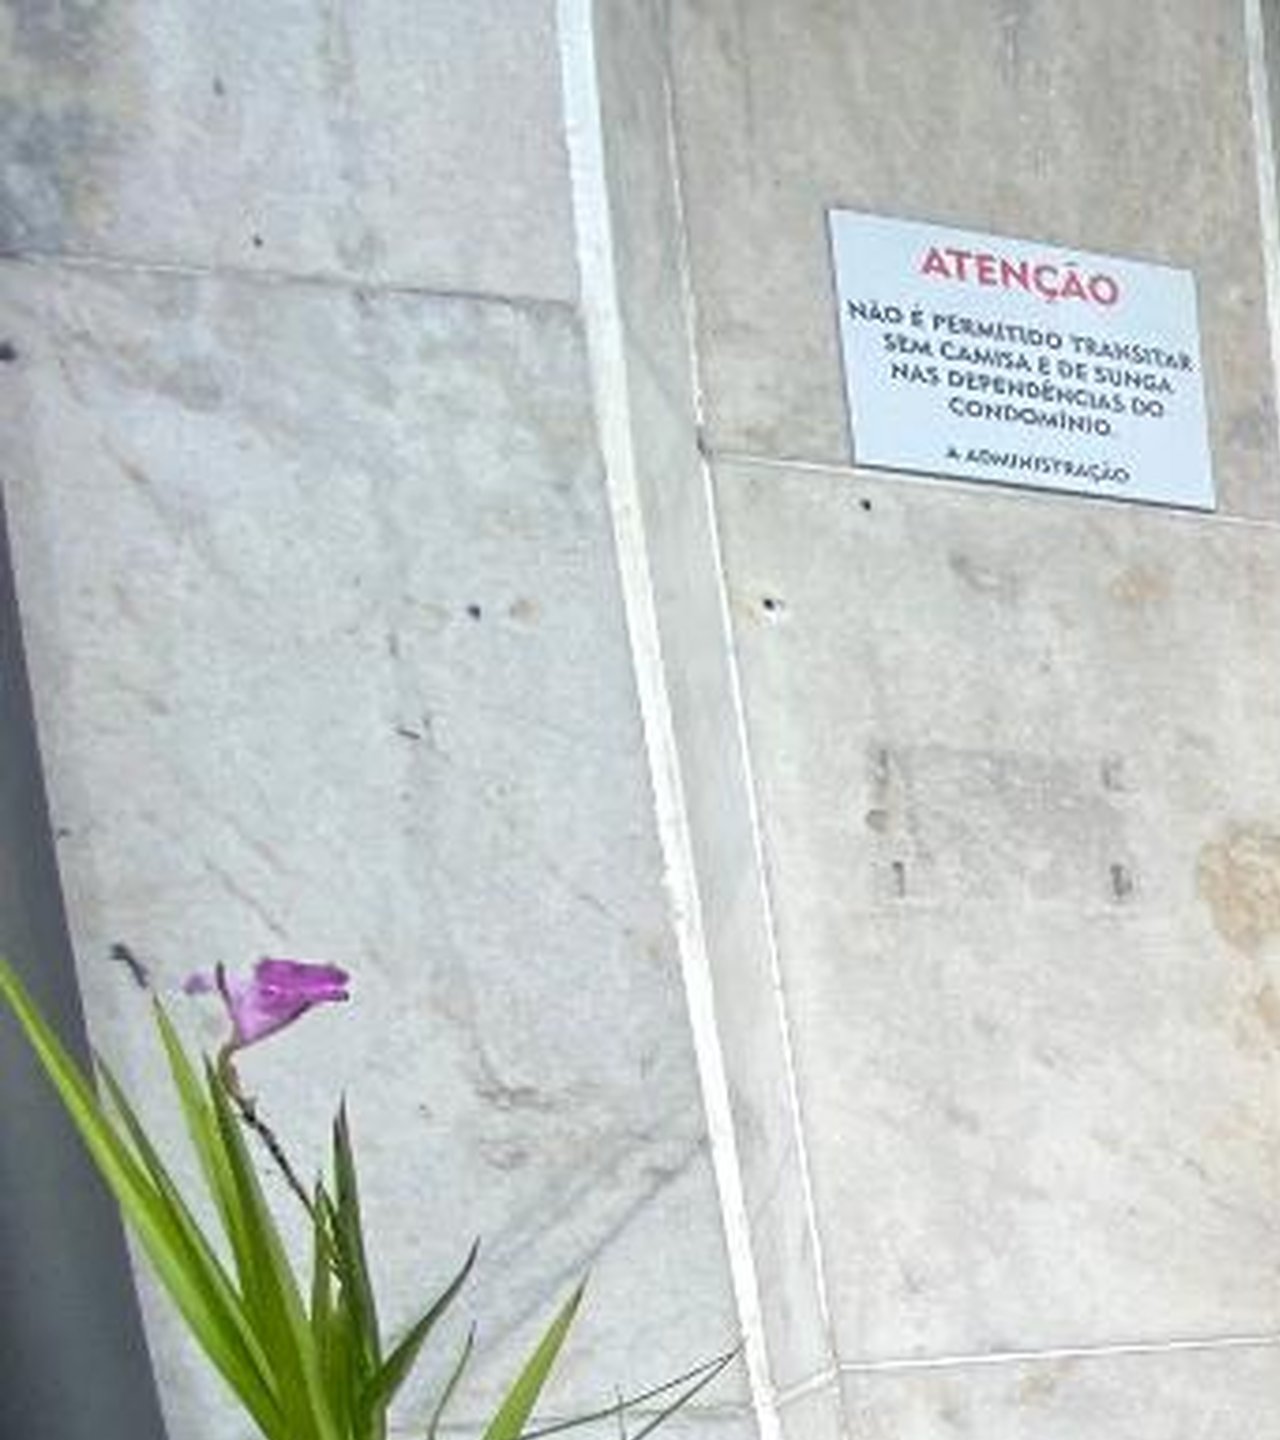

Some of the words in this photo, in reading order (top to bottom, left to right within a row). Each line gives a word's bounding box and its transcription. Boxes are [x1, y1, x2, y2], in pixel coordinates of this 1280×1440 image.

[920, 246, 1120, 307] ATENÇÃO
[847, 299, 904, 325] NÃO
[911, 302, 924, 327] É
[932, 313, 1063, 350] PERMITIDO
[1070, 334, 1194, 373] TRANSITAR
[883, 332, 934, 357] SEM
[940, 340, 1032, 373] CAMISA
[1038, 356, 1051, 376] E
[1057, 359, 1088, 380] DE
[1094, 366, 1175, 395] SUNGA
[891, 363, 940, 386] NAS
[948, 370, 1126, 414] DEPENDÊNCIAS
[1131, 396, 1165, 418] DO
[946, 444, 961, 460] A
[964, 449, 1131, 484] ADMINISTRAÇÃO
